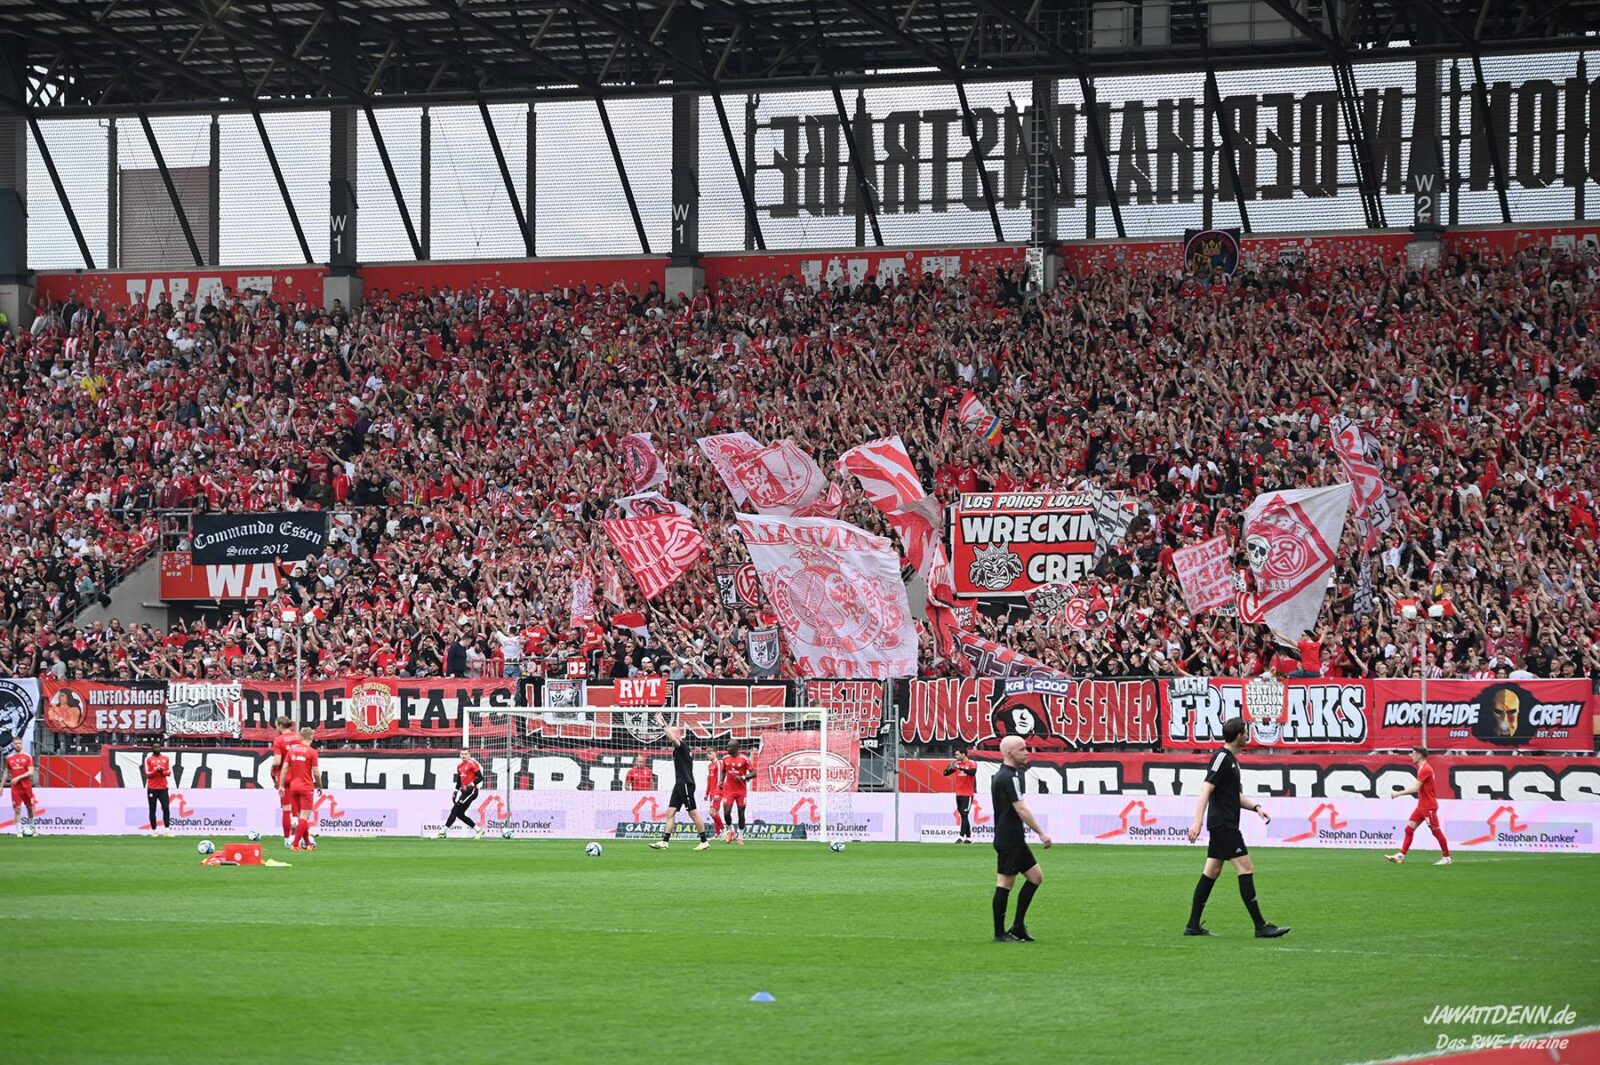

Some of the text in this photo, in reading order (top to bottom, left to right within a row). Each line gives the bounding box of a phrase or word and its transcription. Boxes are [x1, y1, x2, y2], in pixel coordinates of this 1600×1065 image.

[1415, 174, 1435, 192] W
[674, 204, 690, 221] W
[1418, 196, 1431, 217] 2
[330, 214, 348, 231] W
[677, 224, 685, 245] 1
[334, 235, 342, 254] 1
[965, 495, 993, 509] LOS
[193, 520, 322, 550] Commando Essen
[226, 543, 289, 557] Since 2012
[619, 679, 661, 699] RVT
[806, 681, 882, 702] SEKTION
[1034, 678, 1070, 694] 2000
[244, 686, 512, 730] RUDE FANS
[900, 677, 1160, 744] JUNGE ESSENER
[1384, 702, 1582, 726] NORTHSIDE CREW
[95, 709, 162, 730] ESSEN
[21, 817, 53, 826] Stphan
[169, 818, 232, 827] Stephan Dunker
[320, 819, 383, 829] Stephan Dunker
[522, 820, 551, 829] Dunker
[626, 823, 699, 833] GARTEBAU
[837, 823, 867, 832] Dunker
[1129, 826, 1161, 836] Stephan
[1319, 829, 1393, 840] Stephan Dunker
[1498, 832, 1575, 843] Stephan Dunker
